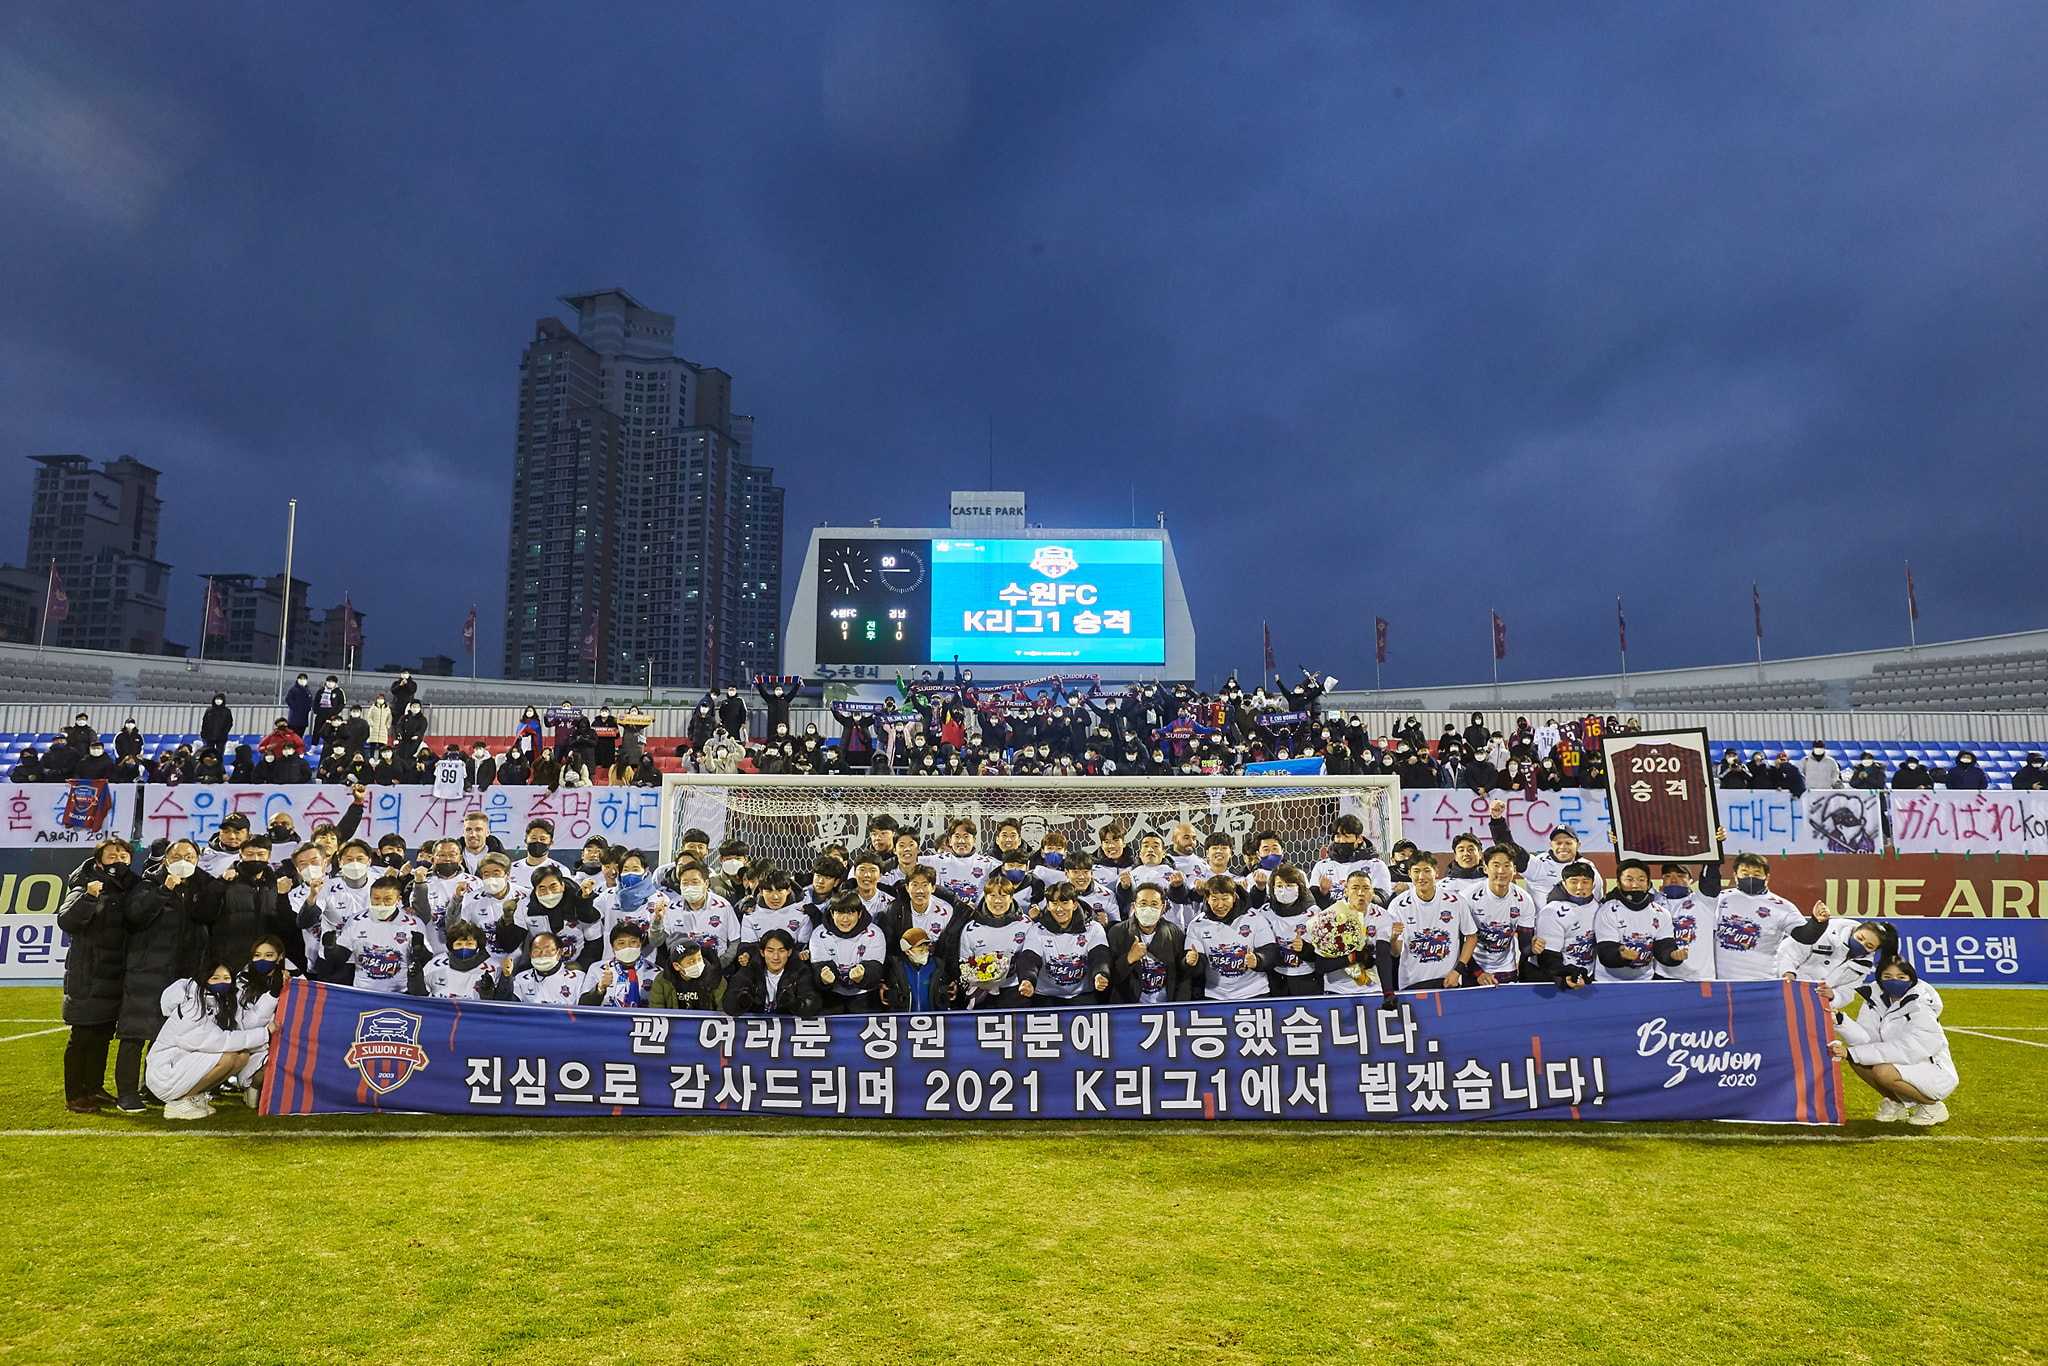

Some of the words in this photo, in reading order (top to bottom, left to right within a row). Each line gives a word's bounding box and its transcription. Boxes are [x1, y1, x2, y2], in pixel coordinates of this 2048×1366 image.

[952, 506, 992, 516] CASTLE
[995, 506, 1024, 516] PARK
[999, 582, 1098, 606] 수원FC
[830, 609, 857, 618] 수원FC
[841, 621, 849, 630] 0
[896, 621, 902, 630] 1
[963, 609, 1061, 633] K리그1
[1072, 610, 1131, 634] 승격
[842, 631, 848, 640] 1
[895, 631, 903, 640] 0
[838, 666, 879, 679] 수원시
[1218, 711, 1225, 724] 9
[1587, 724, 1600, 737] 16
[1563, 752, 1580, 766] 20
[1631, 757, 1681, 773] 2020
[441, 769, 457, 783] 99
[1630, 780, 1652, 802] 승
[1666, 779, 1688, 801] 격
[1897, 794, 2021, 842] がんばれ
[35, 830, 79, 843] Again
[1825, 879, 1926, 917] WE
[1940, 879, 2048, 917] AR
[1675, 929, 1692, 939] UP!
[1734, 933, 1753, 945] UP!
[1497, 936, 1511, 947] UP!
[1430, 944, 1445, 954] UP!
[361, 956, 380, 967] RISE
[380, 961, 397, 972] UP!
[1212, 956, 1230, 965] RISE
[1283, 954, 1299, 964] UP!
[1068, 967, 1084, 978] UP!
[1151, 975, 1165, 987] UP!
[630, 1016, 669, 1054] 팬
[700, 1016, 831, 1058] 여러분
[859, 1016, 945, 1059] 성원
[977, 1012, 1109, 1059] 덕분에
[1140, 1003, 1438, 1058] 가능했습니다.
[1636, 1017, 1729, 1057] Brave
[361, 1045, 397, 1055] SUWON
[399, 1046, 414, 1057] FC
[1663, 1049, 1761, 1088] Suwon
[465, 1056, 640, 1106] 진심으로
[669, 1064, 893, 1114] 감사드리며
[925, 1069, 1038, 1112] 2021
[1075, 1063, 1328, 1114] K리그1에서
[1359, 1057, 1604, 1112] 뵙겠습니다!
[1718, 1073, 1757, 1087] 2020
